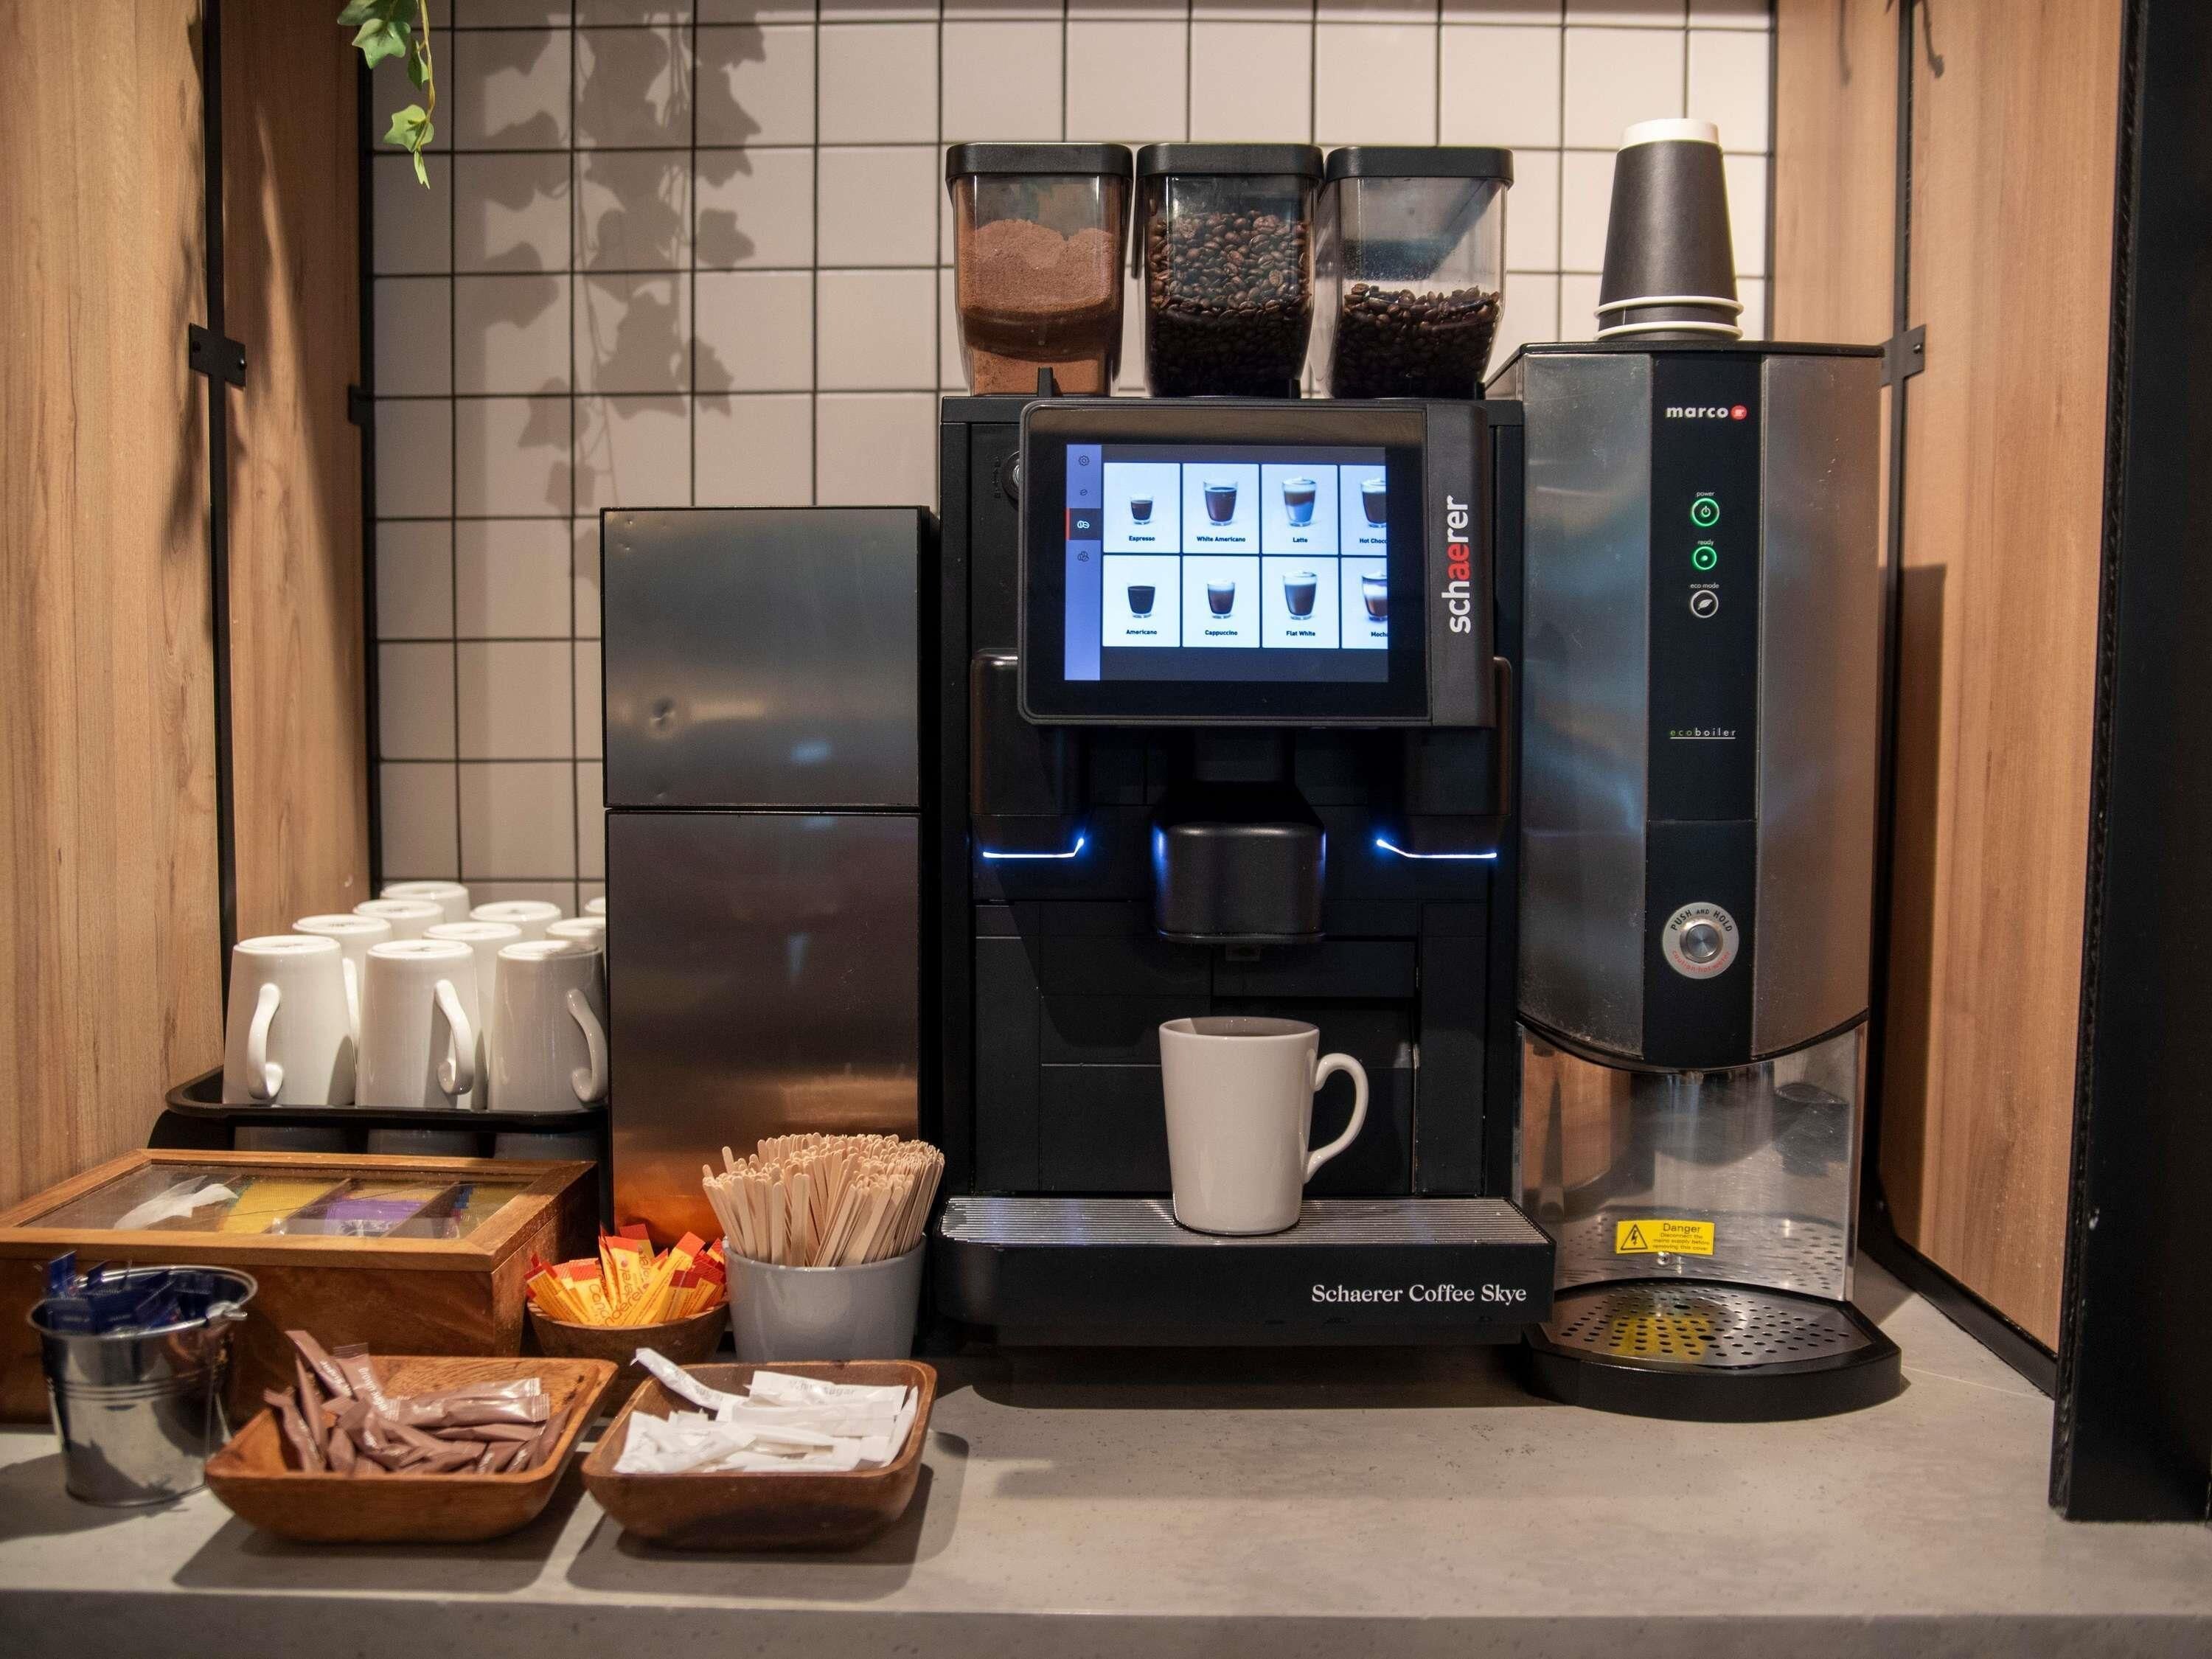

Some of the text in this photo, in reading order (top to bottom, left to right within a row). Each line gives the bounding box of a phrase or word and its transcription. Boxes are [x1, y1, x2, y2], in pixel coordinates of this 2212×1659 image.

[1666, 407, 1729, 419] marco
[1697, 538, 1714, 546] ready
[1441, 495, 1472, 634] schaerer
[1670, 727, 1736, 737] ecoboiler
[1671, 909, 1692, 931] PUSH
[1713, 911, 1733, 932] HOLD
[1662, 1222, 1700, 1234] Danger
[1312, 1284, 1527, 1306] Schaerer Coffee Skye
